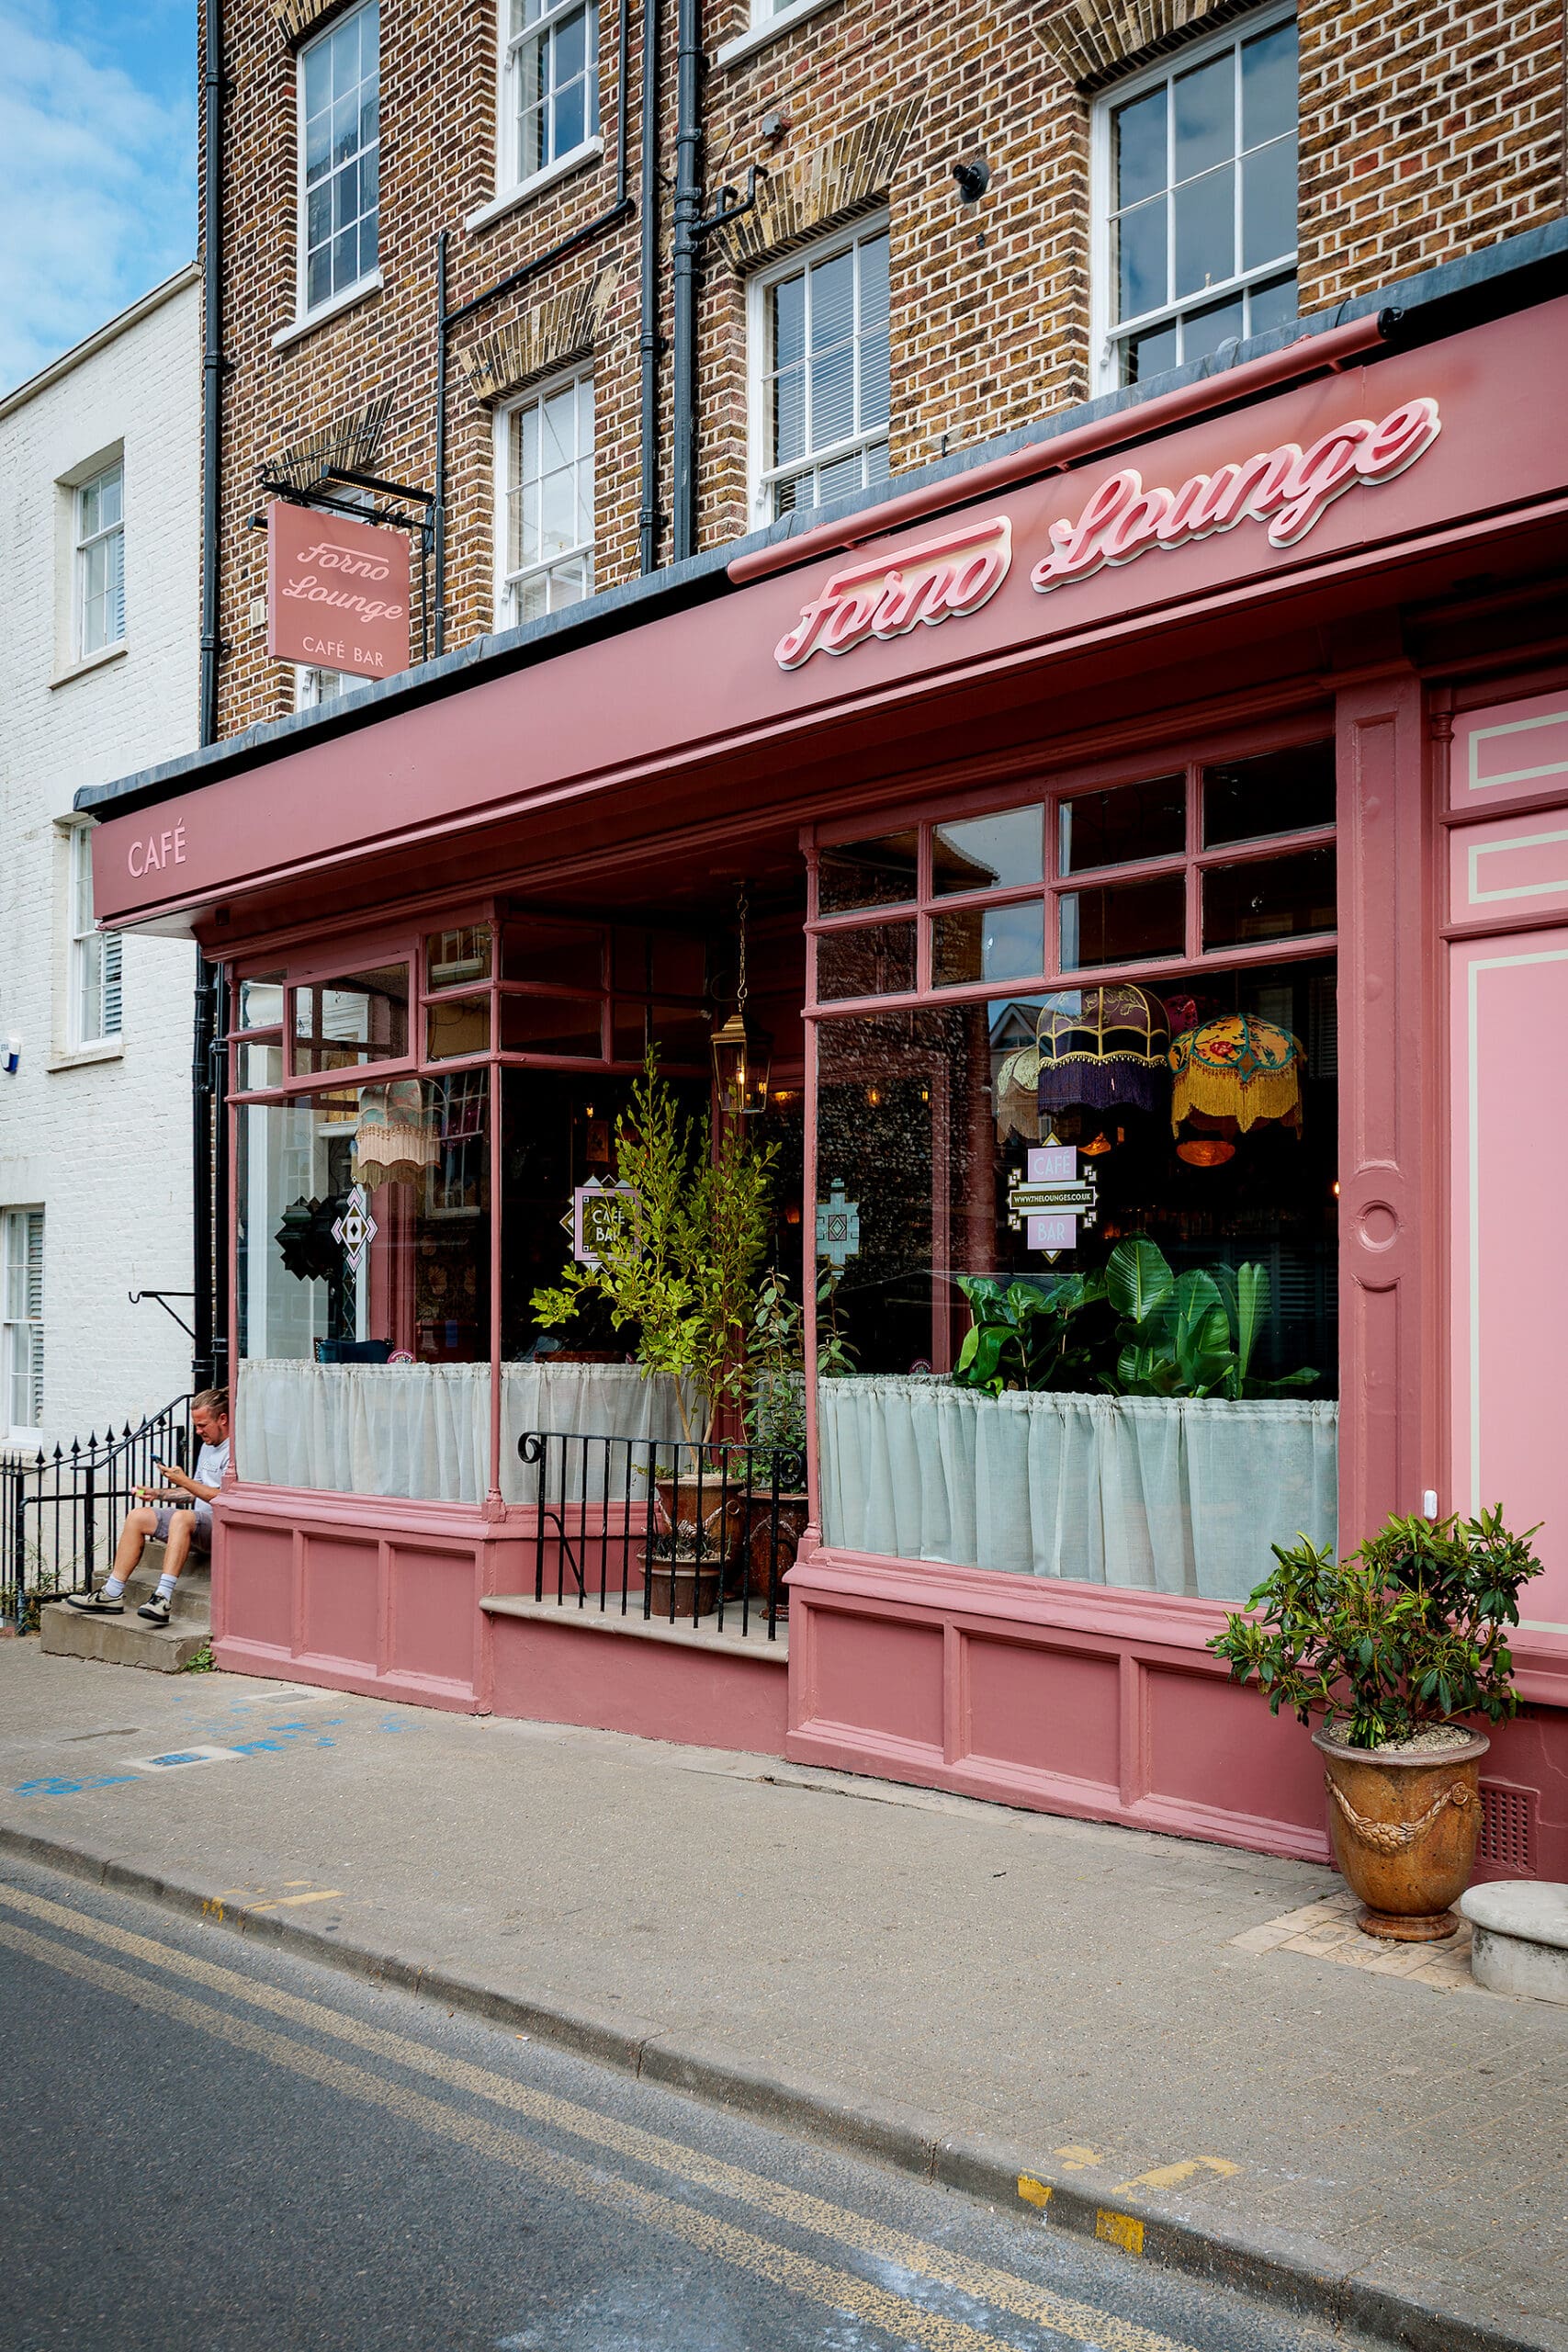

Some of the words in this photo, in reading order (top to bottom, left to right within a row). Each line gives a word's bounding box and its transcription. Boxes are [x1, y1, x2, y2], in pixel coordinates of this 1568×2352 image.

[773, 515, 1012, 670] Forno
[1032, 398, 1441, 594] Lounge
[297, 542, 389, 581] Forno
[281, 575, 403, 623] Lounge
[302, 637, 345, 659] CAFÉ
[354, 647, 384, 667] BAR
[128, 817, 186, 878] CAFÉ
[1033, 1150, 1072, 1176] CAFÉ
[1037, 1222, 1066, 1242] BAR
